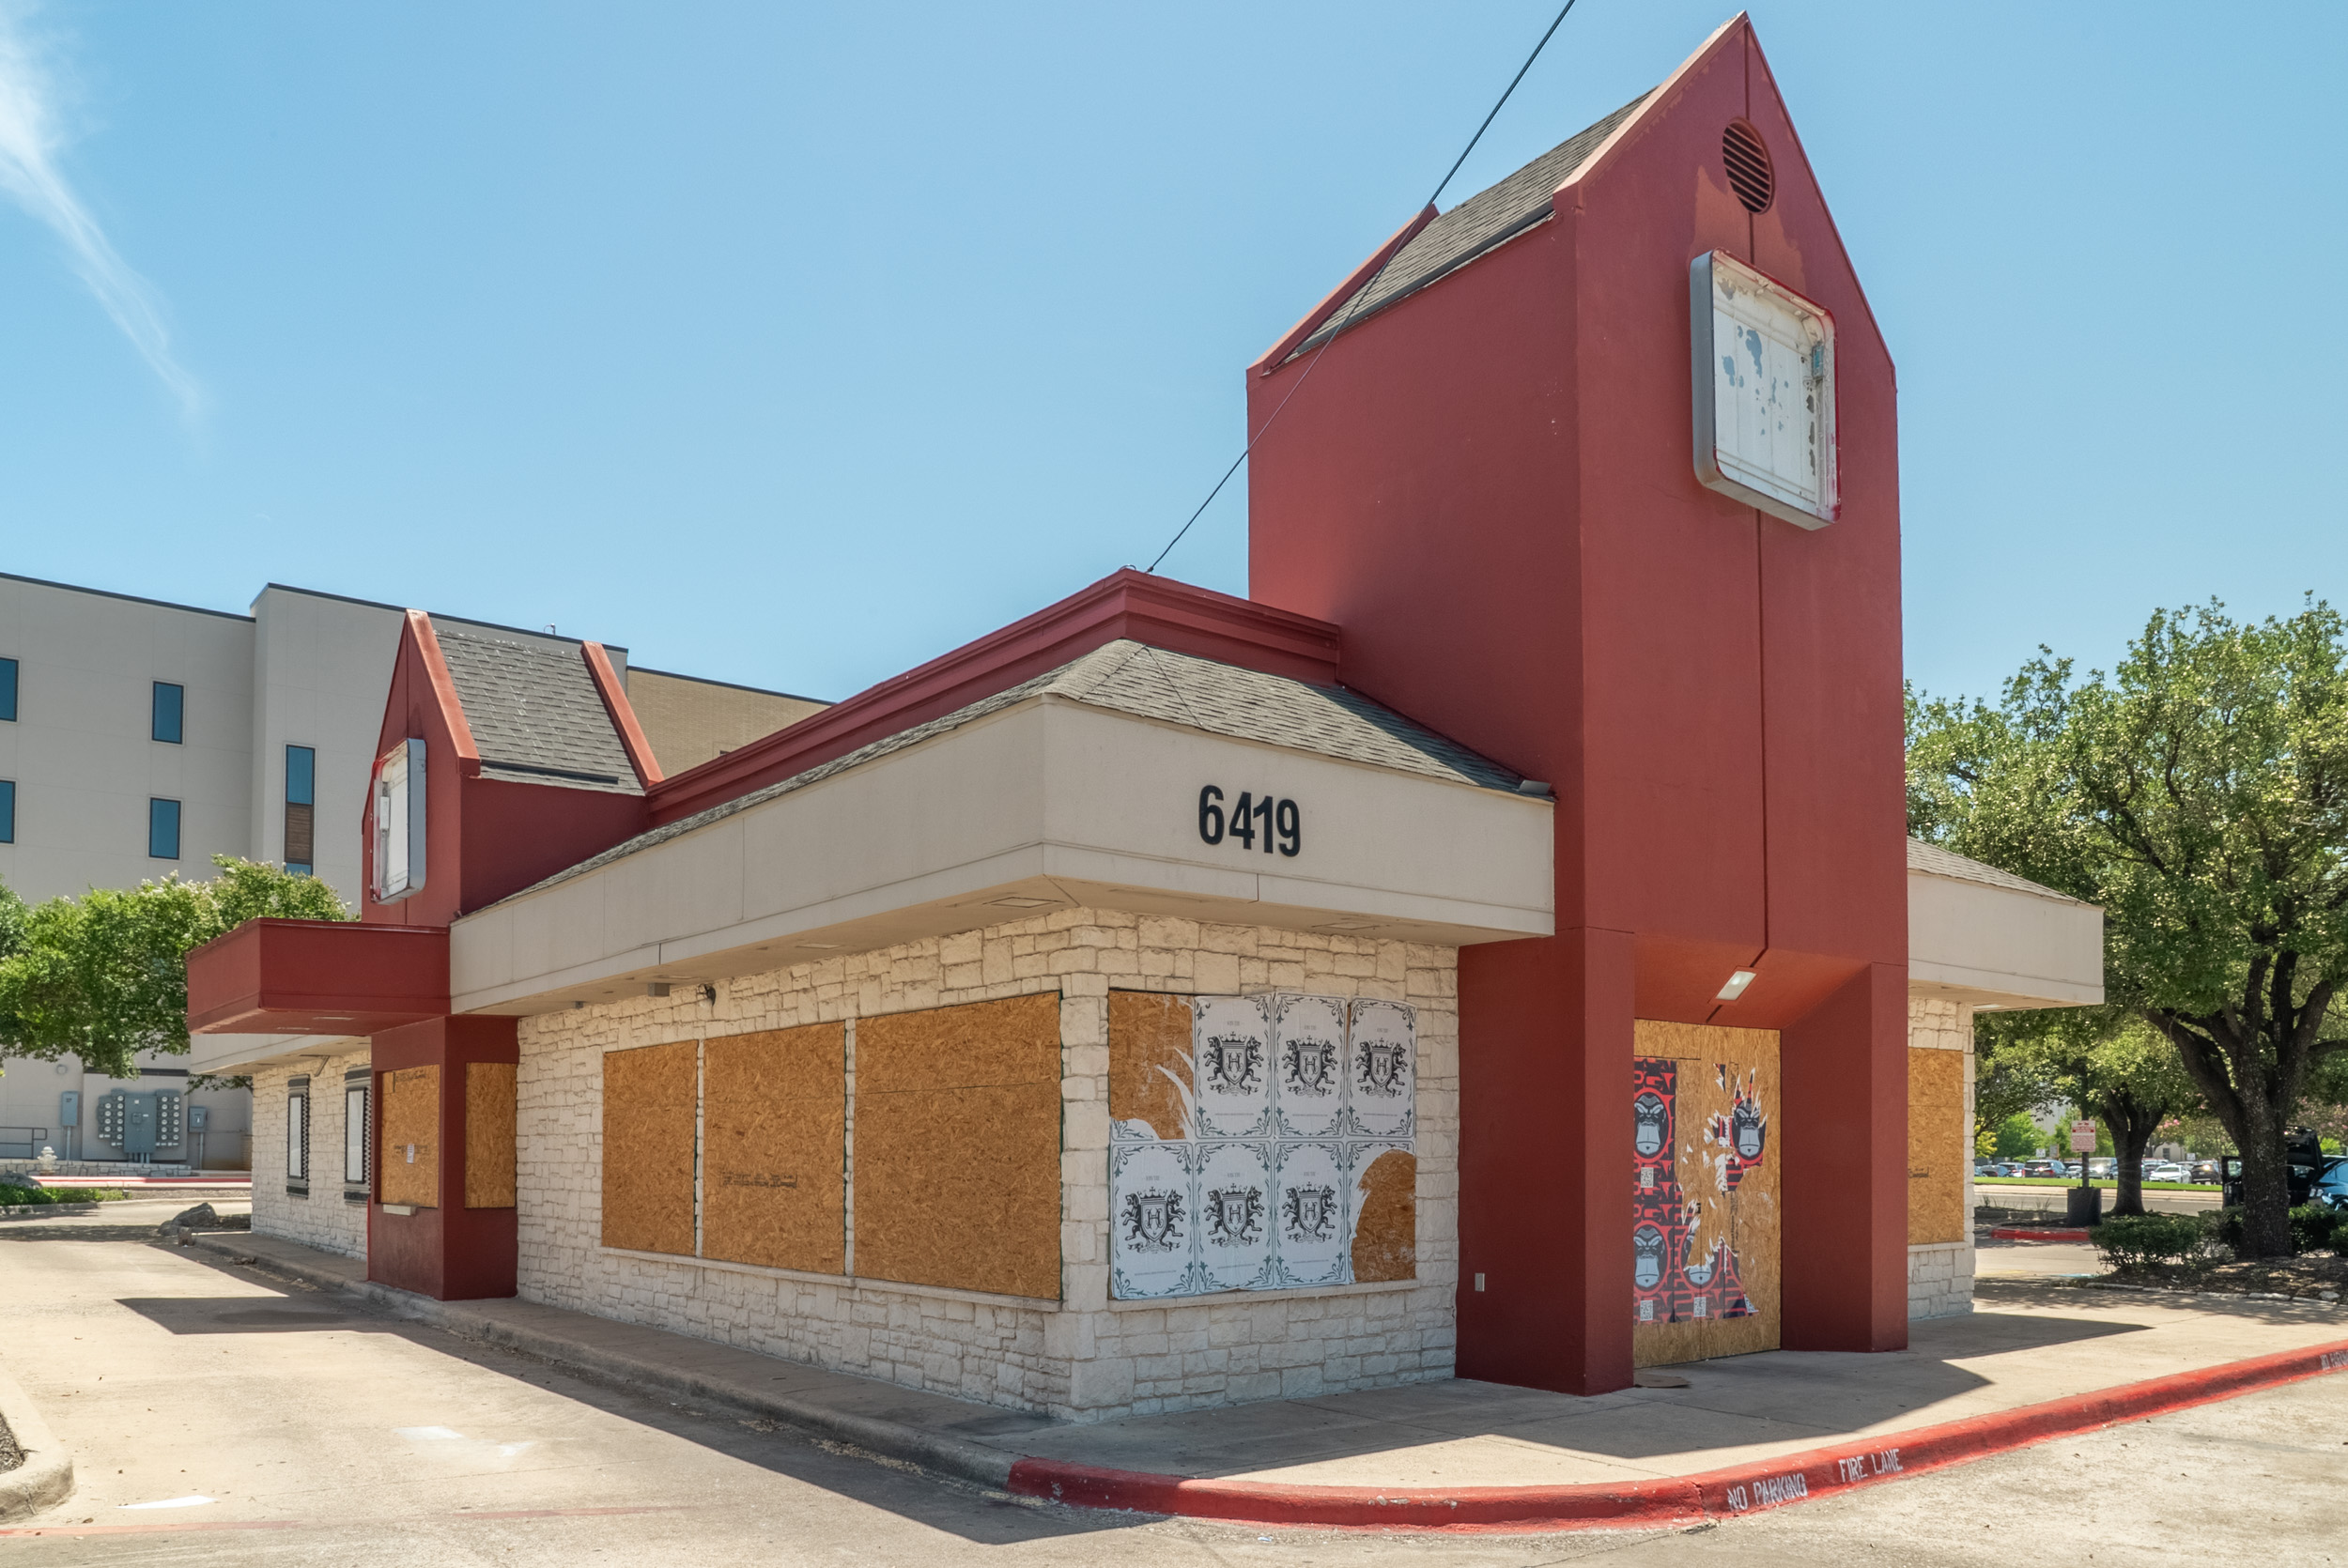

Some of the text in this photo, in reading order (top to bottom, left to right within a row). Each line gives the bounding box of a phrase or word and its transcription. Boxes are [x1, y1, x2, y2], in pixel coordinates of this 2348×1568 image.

[1198, 785, 1301, 857] 6419
[1226, 1053, 1244, 1072] H
[1303, 1054, 1318, 1075] H
[1374, 1057, 1388, 1077] H
[1146, 1207, 1164, 1229] H
[1227, 1204, 1244, 1224] H
[1304, 1202, 1318, 1222] H
[1838, 1449, 1903, 1483] FIRE LANE
[1727, 1472, 1808, 1511] NO PARKING
